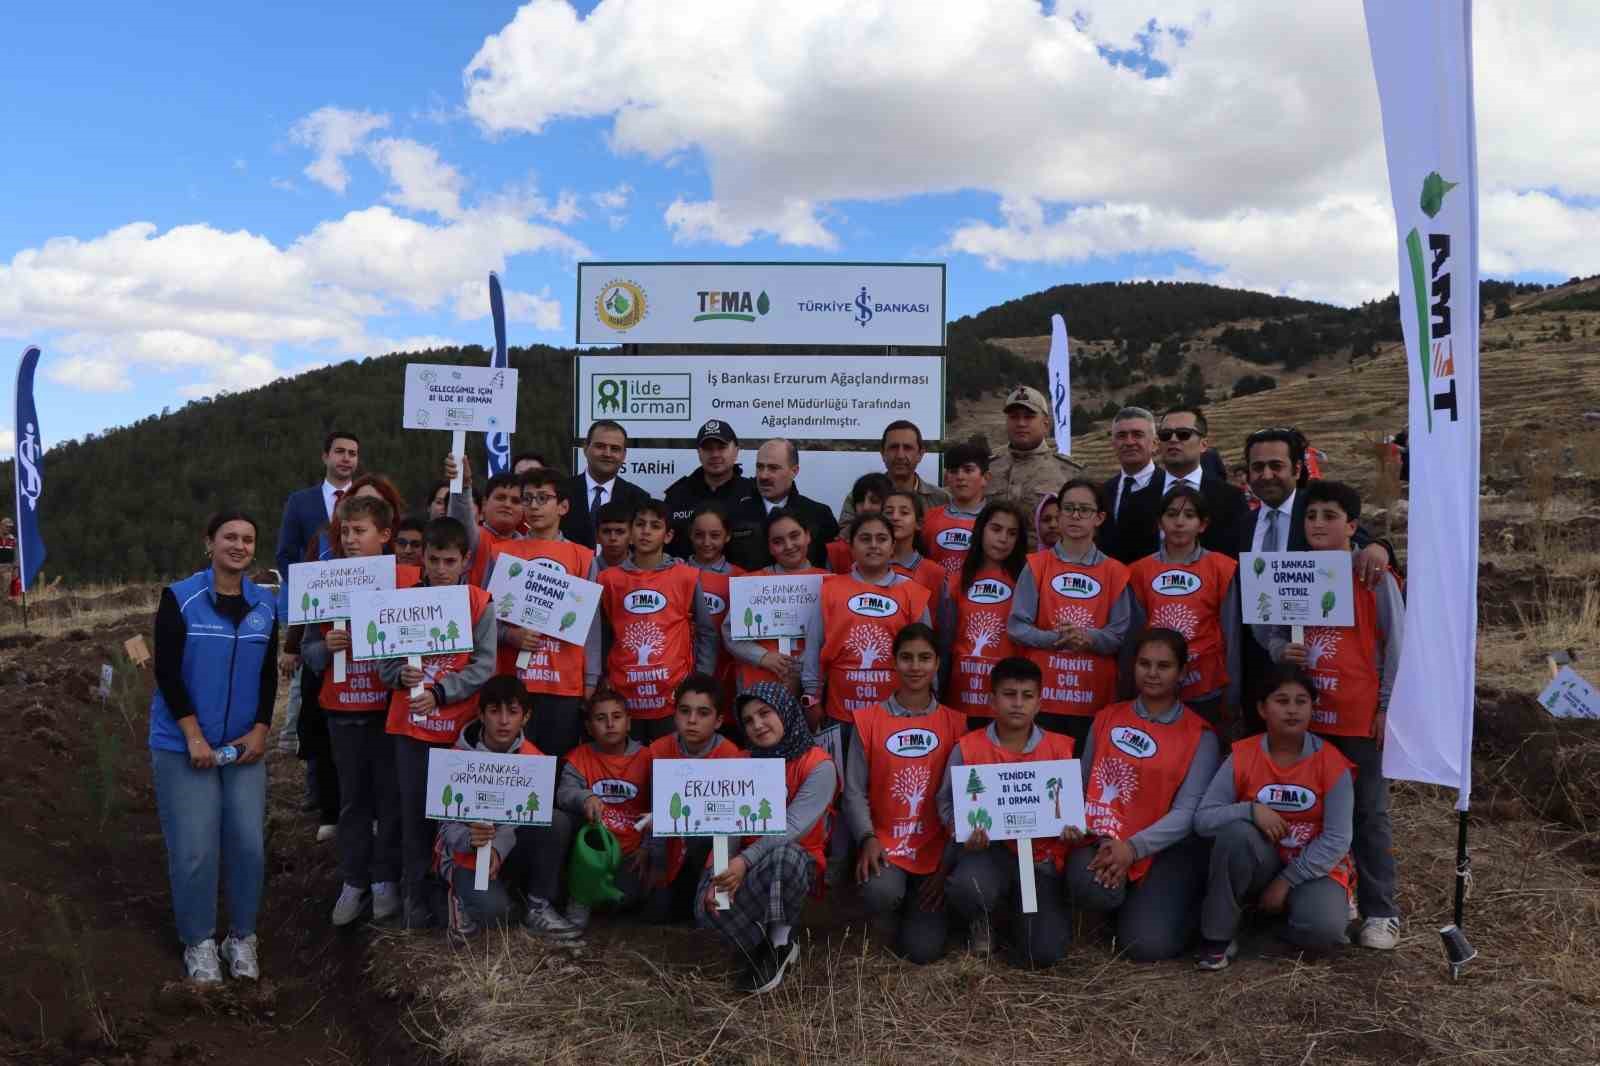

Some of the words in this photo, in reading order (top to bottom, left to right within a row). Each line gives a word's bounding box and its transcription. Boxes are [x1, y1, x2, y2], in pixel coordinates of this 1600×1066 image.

[697, 292, 753, 313] TEMA
[797, 300, 853, 312] TÜRKİYE
[875, 303, 929, 313] BANKASI
[708, 370, 718, 387] İş
[721, 372, 770, 384] Bankası
[774, 372, 827, 384] Erzurum
[830, 372, 929, 387] Ağaçlandırması
[630, 380, 661, 395] ilde
[630, 403, 685, 414] orman
[712, 398, 749, 408] Orman
[752, 398, 784, 409] Genel
[787, 398, 848, 411] Müdürlüğü
[851, 398, 911, 409] Tarafından
[761, 415, 861, 428] Ağaçlandırılmıştır.
[631, 459, 675, 475] TARİHİ
[1281, 560, 1316, 569] BANKASI
[1063, 576, 1087, 590] TEMA
[1161, 574, 1186, 586] TEMA
[1273, 571, 1315, 583] ORMANI
[525, 580, 565, 601] ORMANI
[974, 584, 998, 595] TEMA
[632, 594, 653, 605] TEMA
[858, 597, 883, 609] TEMA
[379, 605, 443, 625] ERZURUM
[1057, 672, 1080, 688] ÇÖL
[856, 684, 879, 699] ÇÖL
[898, 734, 925, 746] TEMA
[997, 770, 1036, 780] YENİDEN
[684, 779, 756, 798] ERZURUM
[1013, 782, 1033, 793] İLDE
[1008, 795, 1040, 806] ORMAN
[1270, 788, 1299, 802] TEMA
